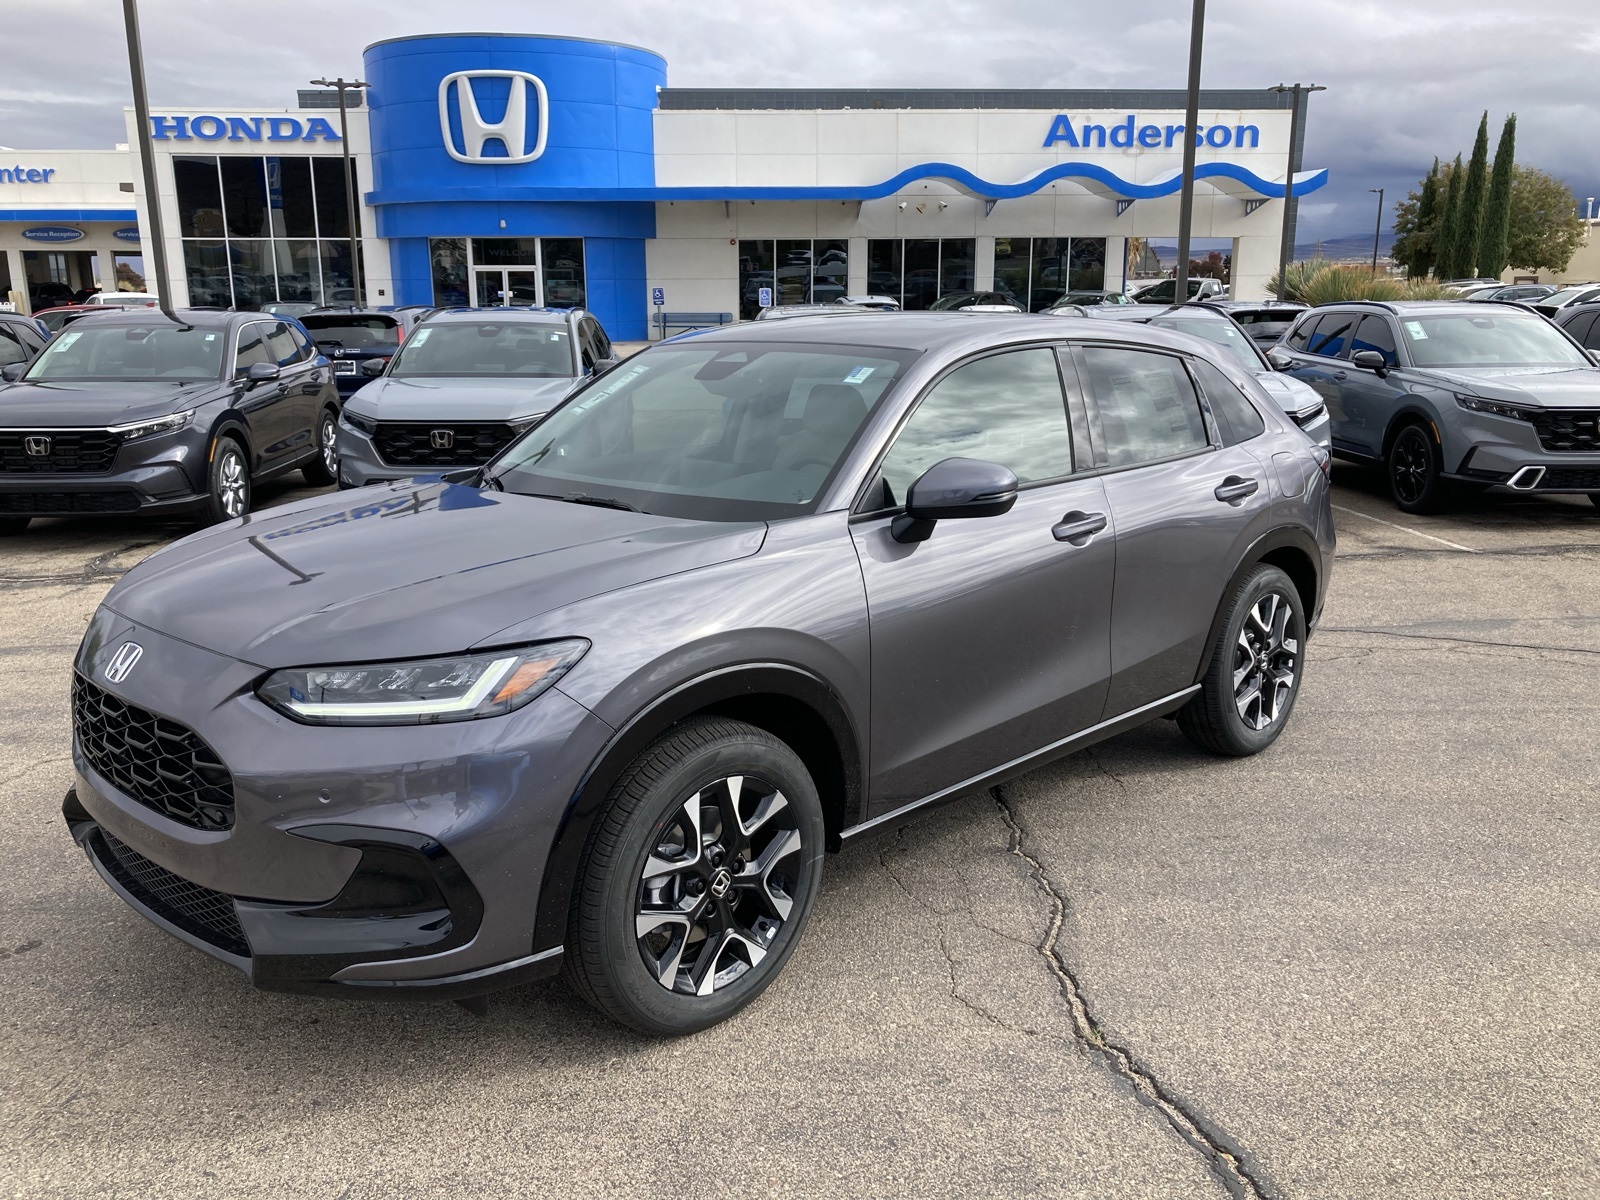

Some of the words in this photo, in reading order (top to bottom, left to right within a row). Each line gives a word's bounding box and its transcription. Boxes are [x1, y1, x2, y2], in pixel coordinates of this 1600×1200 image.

[149, 115, 342, 142] HONDA
[0, 165, 55, 183] nter
[489, 249, 535, 257] WELCOM
